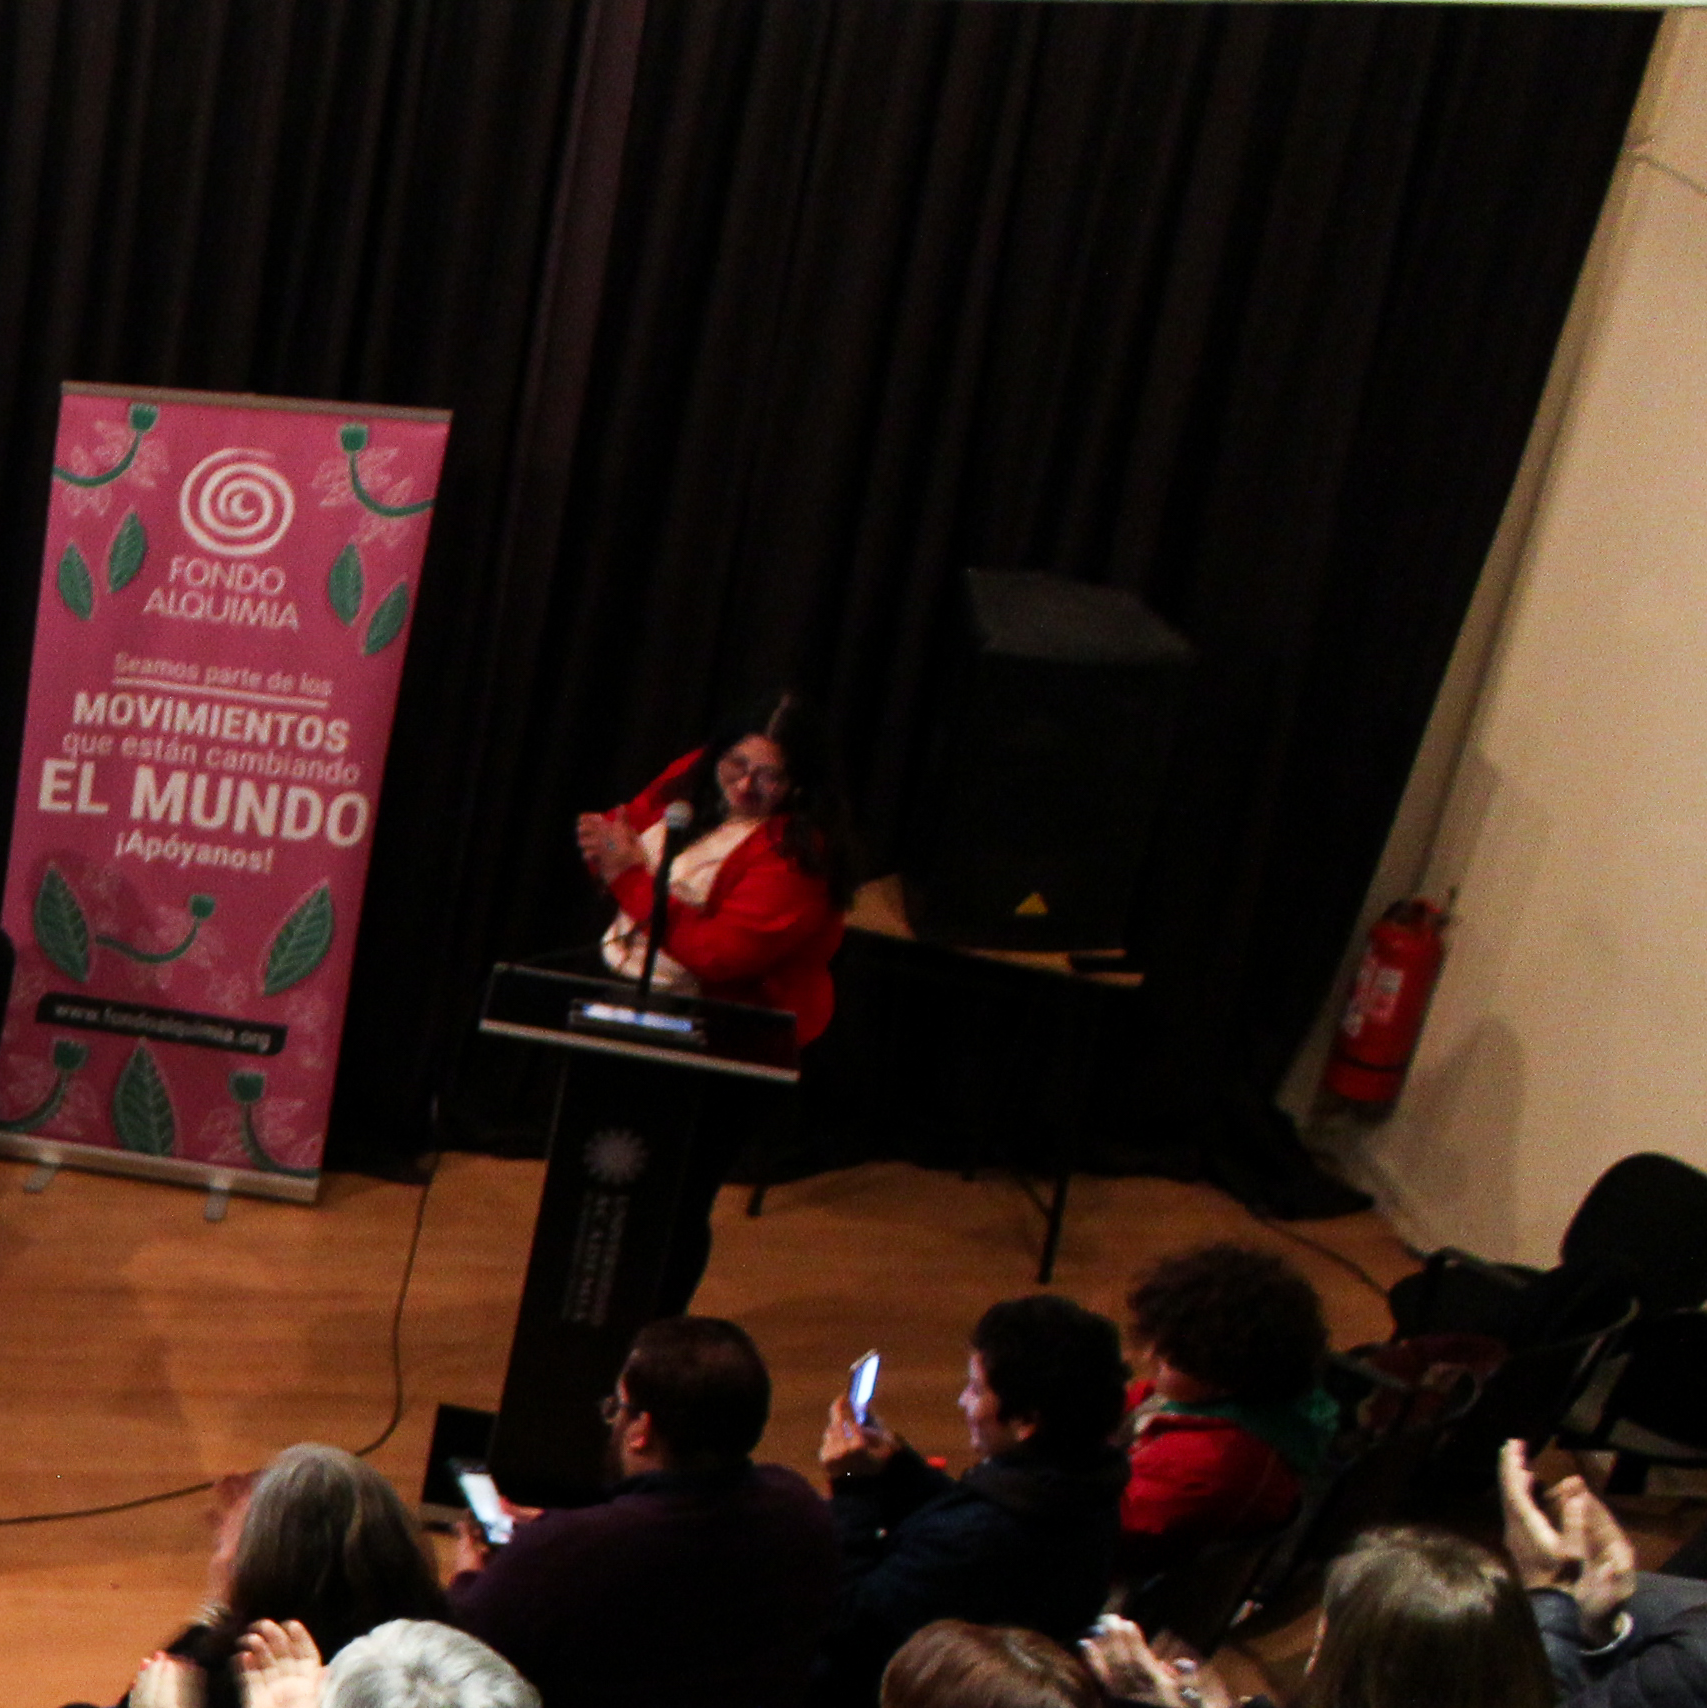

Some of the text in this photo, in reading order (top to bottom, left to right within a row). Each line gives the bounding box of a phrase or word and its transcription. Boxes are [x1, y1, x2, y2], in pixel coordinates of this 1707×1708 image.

[168, 556, 286, 595] FONDO
[143, 586, 299, 631] ALQUIMIA
[204, 666, 262, 689] parte
[267, 669, 296, 693] de
[299, 672, 333, 697] los
[73, 692, 350, 754] MOVIMIENTOS
[62, 732, 361, 785] que están cambiando
[37, 757, 372, 847] EL MUNDO
[115, 829, 273, 874] ¡Apóyanos!
